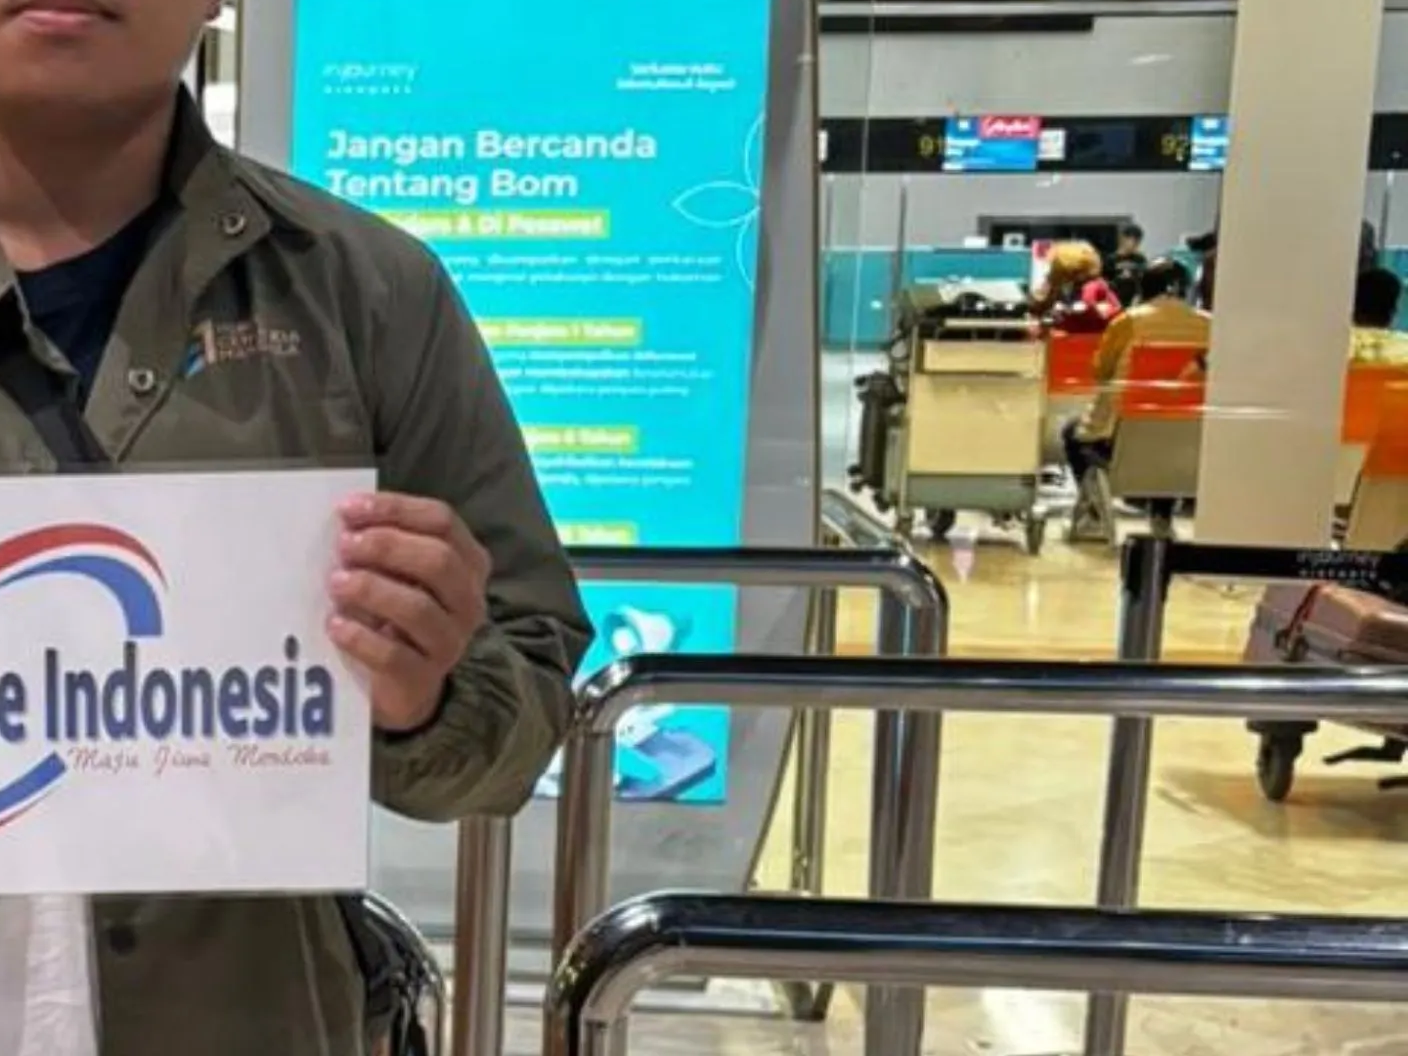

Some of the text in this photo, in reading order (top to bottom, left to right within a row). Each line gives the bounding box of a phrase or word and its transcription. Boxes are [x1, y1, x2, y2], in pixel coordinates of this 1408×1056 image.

[326, 128, 657, 165] Jangan Bercanda
[326, 168, 578, 204] Tentang Bom
[44, 635, 335, 742] Indonesia
